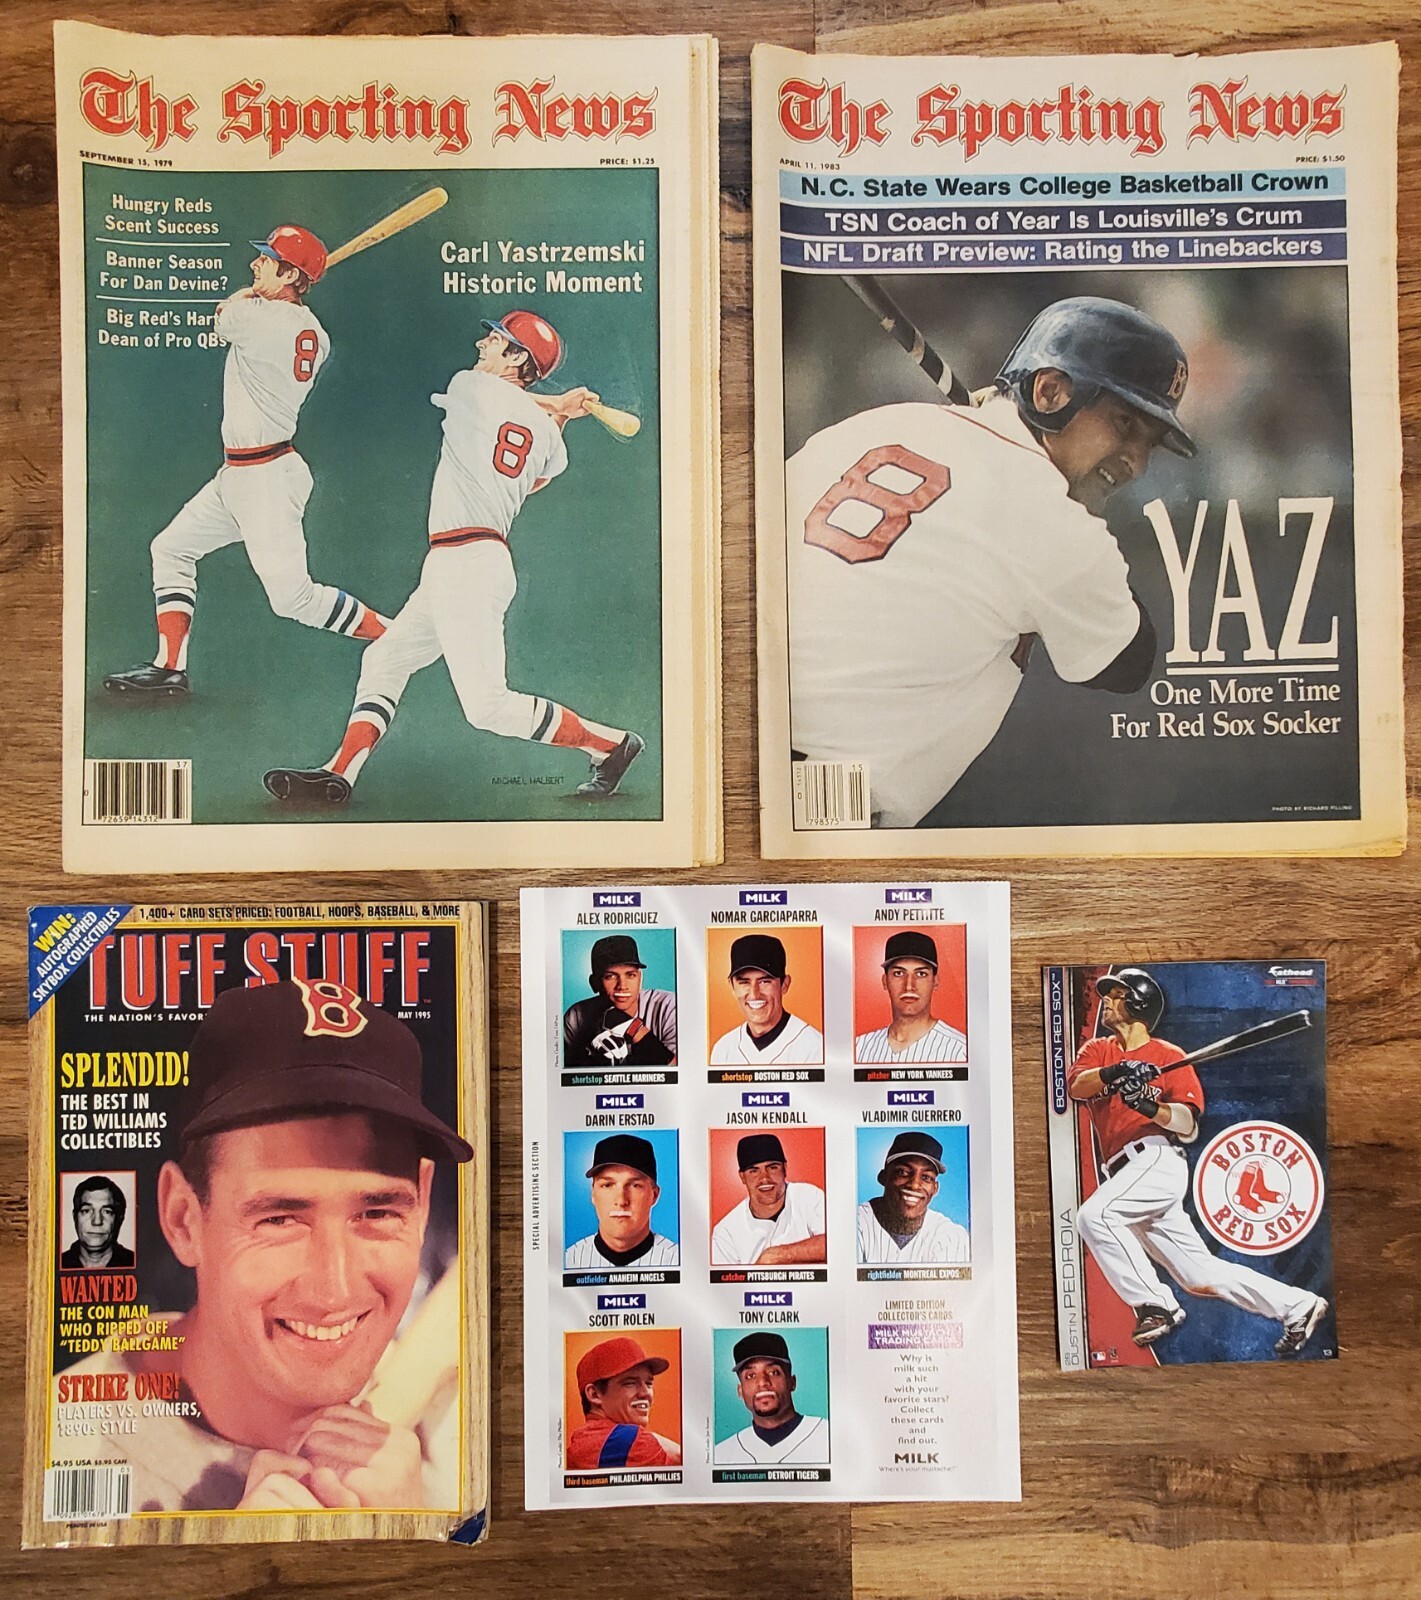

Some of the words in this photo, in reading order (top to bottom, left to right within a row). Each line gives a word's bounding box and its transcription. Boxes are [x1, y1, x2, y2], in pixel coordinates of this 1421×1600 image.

[80, 66, 199, 152] The
[216, 78, 472, 159] Sporting
[492, 75, 658, 148] News
[778, 77, 893, 158] The
[910, 82, 1168, 162] Sporting
[1187, 74, 1348, 150] News
[80, 150, 134, 164] SEPTEMBER
[138, 159, 150, 167] 15,
[154, 160, 172, 168] 1979
[632, 158, 655, 166] $1.25
[780, 158, 802, 168] APRIL
[805, 162, 818, 170] 11,
[1322, 155, 1346, 163] $1.50
[801, 176, 855, 198] N.C.
[864, 178, 928, 198] State
[935, 178, 1011, 196] Wears
[1020, 176, 1111, 199] College
[1120, 173, 1243, 194] Basketball
[1251, 172, 1328, 192] Crown
[112, 194, 170, 214] Hungry
[174, 198, 212, 214] Reds
[105, 216, 152, 234] Scent
[157, 217, 220, 235] Success
[825, 212, 878, 232] TSN
[888, 211, 966, 231] Coach
[975, 210, 999, 230] of
[1006, 210, 1060, 230] Year
[1070, 210, 1090, 228] Is
[1099, 208, 1228, 229] Louisville's
[1236, 206, 1302, 226] Crum
[441, 240, 488, 264] Carl
[497, 240, 646, 263] Yastrzemski
[803, 242, 853, 263] NFL
[862, 242, 924, 263] Draft
[933, 242, 1036, 262] Preview:
[1045, 240, 1123, 263] Rating
[1132, 238, 1170, 258] the
[1178, 238, 1323, 259] Linebackers
[106, 251, 162, 269] Banner
[168, 253, 223, 270] Season
[100, 272, 128, 289] For
[133, 274, 163, 291] Dan
[168, 275, 229, 292] Devine?
[443, 272, 536, 294] Historic
[546, 270, 643, 293] Moment
[106, 308, 134, 328] Big
[140, 310, 181, 327] Red's
[186, 312, 220, 327] Hart
[98, 330, 139, 347] Dean
[144, 330, 160, 348] of
[166, 332, 192, 348] Pro
[197, 331, 228, 349] QBs
[293, 330, 318, 382] 8
[492, 420, 534, 478] 8
[804, 444, 951, 564] 8
[1143, 496, 1338, 664] YAZ
[1150, 680, 1202, 706] One
[1208, 678, 1273, 704] More
[1278, 676, 1341, 702] Time
[1110, 714, 1150, 739] For
[1157, 712, 1206, 738] Red
[1213, 711, 1256, 737] Sox
[1263, 710, 1342, 736] Socker
[491, 776, 527, 786] MICHAEL
[600, 894, 635, 905] MILK
[746, 893, 781, 904] MILK
[140, 908, 176, 920] 1,400+
[180, 908, 206, 918] CARD
[208, 907, 232, 918] SETS
[236, 907, 272, 918] PRICED:
[275, 906, 324, 919] FOOTBALL,
[328, 906, 364, 918] HOOPS,
[368, 905, 418, 918] BASEBALL,
[422, 906, 430, 916] &
[433, 905, 460, 916] MORE
[577, 912, 600, 925] ALEX
[604, 912, 658, 925] RODRIGUEZ
[711, 910, 747, 924] NOMAR
[750, 910, 818, 923] GARCIAPARRA
[33, 912, 76, 954] WIN:
[36, 911, 98, 978] AUTOGRAPHED
[32, 965, 70, 1002] SKYBOX
[66, 907, 122, 966] COLLECTIBLES
[90, 933, 226, 1010] TUFF
[244, 932, 431, 1007] STUFF
[1268, 966, 1314, 977] Fathead
[292, 976, 368, 1038] B
[398, 1012, 412, 1020] MAY
[414, 1011, 431, 1020] 1995
[84, 1014, 104, 1023] THE
[109, 1013, 164, 1022] NATION'S
[168, 1012, 208, 1022] FAVOR
[1053, 1014, 1063, 1043] RED
[61, 1050, 190, 1088] SPLENDID!
[722, 1072, 752, 1082] shortstop
[754, 1072, 780, 1081] BOSTON
[782, 1071, 795, 1080] RED
[796, 1070, 809, 1080] SOX
[1053, 1048, 1064, 1108] BOSTON
[572, 1075, 602, 1085] shortstop
[604, 1074, 630, 1084] SEATTLE
[632, 1073, 666, 1083] MARINERS
[61, 1094, 88, 1111] THE
[94, 1093, 128, 1110] BEST
[133, 1092, 149, 1110] IN
[602, 1096, 638, 1106] MILK
[61, 1114, 88, 1130] TED
[92, 1112, 167, 1130] WILLIAMS
[586, 1114, 615, 1127] DARIN
[618, 1113, 655, 1126] ERSTAD
[726, 1112, 758, 1125] JASON
[762, 1111, 808, 1124] KENDALL
[862, 1110, 908, 1123] VLADIMIR
[912, 1109, 962, 1122] GUERRERO
[61, 1132, 162, 1150] COLLECTIBLES
[532, 1141, 540, 1171] SECTION
[1212, 1132, 1303, 1172] BOSTON
[532, 1172, 540, 1220] ADVERTISING
[1212, 1204, 1254, 1242] RED
[1264, 1202, 1306, 1242] SOX
[532, 1221, 540, 1251] SPECIAL
[1060, 1208, 1076, 1309] PEDROIA
[60, 1274, 138, 1304] WANTED
[60, 1307, 83, 1320] THE
[88, 1306, 114, 1320] CON
[118, 1304, 148, 1320] MAN
[589, 1314, 620, 1327] SCOTT
[623, 1313, 655, 1326] ROLEN
[739, 1311, 764, 1324] TONY
[768, 1310, 800, 1323] CLARK
[60, 1322, 92, 1337] WHO
[96, 1322, 142, 1336] RIPPED
[146, 1320, 168, 1335] OFF
[1069, 1312, 1080, 1366] DUSTIN
[58, 1374, 128, 1404] STRIKE
[135, 1372, 180, 1401] ONE!
[58, 1404, 112, 1421] PLAYERS
[118, 1404, 136, 1419] VS.
[142, 1402, 202, 1418] OWNERS,
[900, 1405, 934, 1414] Collect
[100, 1420, 137, 1436] STYLE
[891, 1416, 916, 1424] these
[919, 1416, 944, 1424] cards
